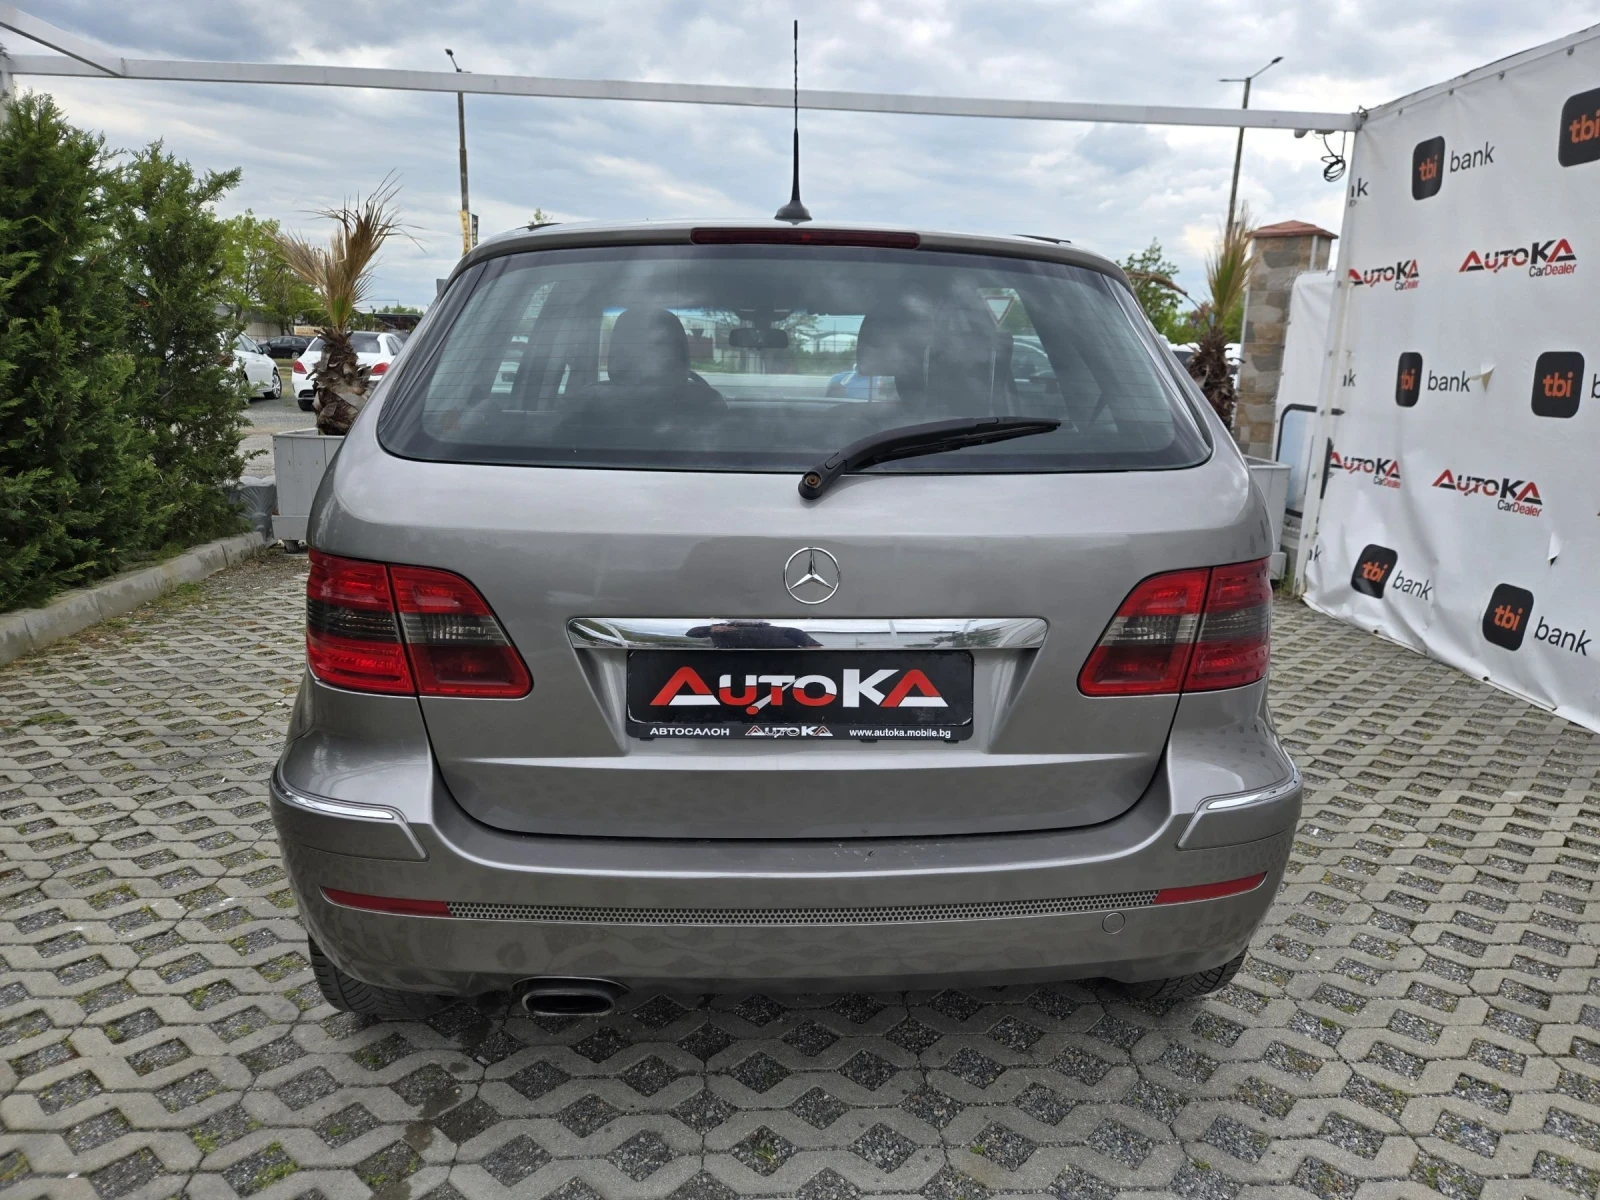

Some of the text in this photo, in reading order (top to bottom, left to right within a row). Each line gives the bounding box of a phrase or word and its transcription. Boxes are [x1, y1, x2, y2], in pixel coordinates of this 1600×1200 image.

[1419, 142, 1495, 181] tbi bank
[1529, 262, 1577, 278] CarDealer
[1400, 368, 1471, 393] tbi bank
[1542, 371, 1574, 398] tbi
[1497, 499, 1543, 517] CarDealer
[1361, 560, 1433, 601] tbi bank
[1494, 604, 1593, 656] tbi bank
[650, 666, 949, 715] AUTOKA
[650, 727, 730, 737] АВТОСАЛОН
[849, 728, 952, 739] www.autoka.mobile.bg
